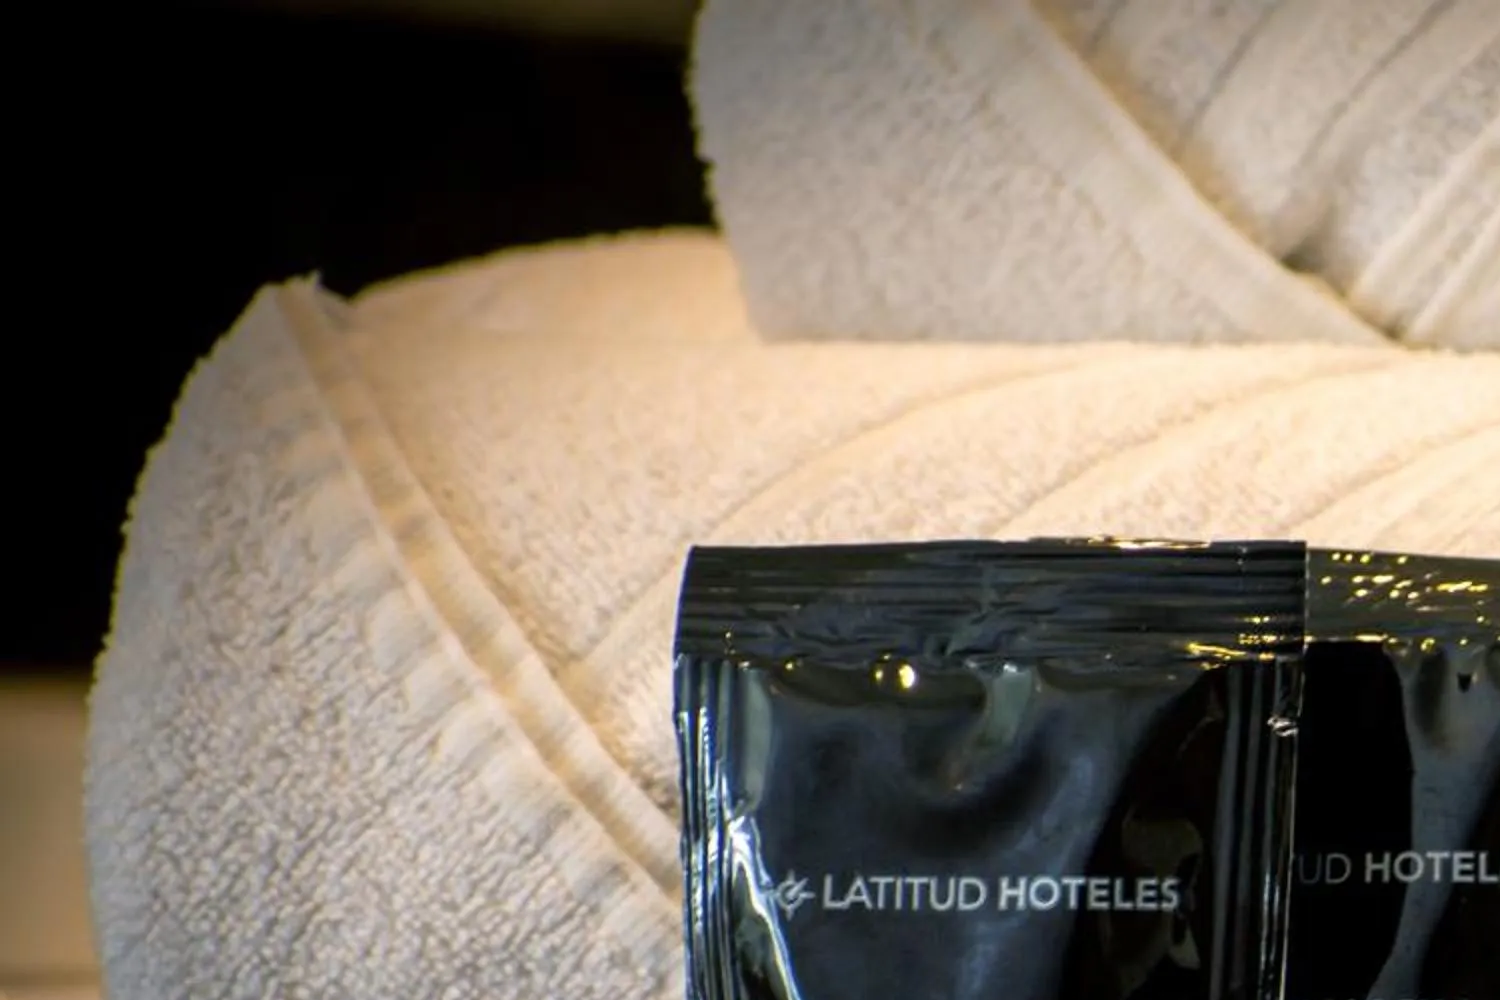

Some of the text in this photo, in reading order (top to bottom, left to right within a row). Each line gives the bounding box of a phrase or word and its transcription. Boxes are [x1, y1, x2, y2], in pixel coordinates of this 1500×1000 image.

[1294, 852, 1352, 885] UD
[823, 874, 1181, 911] LATITUD HOTELES
